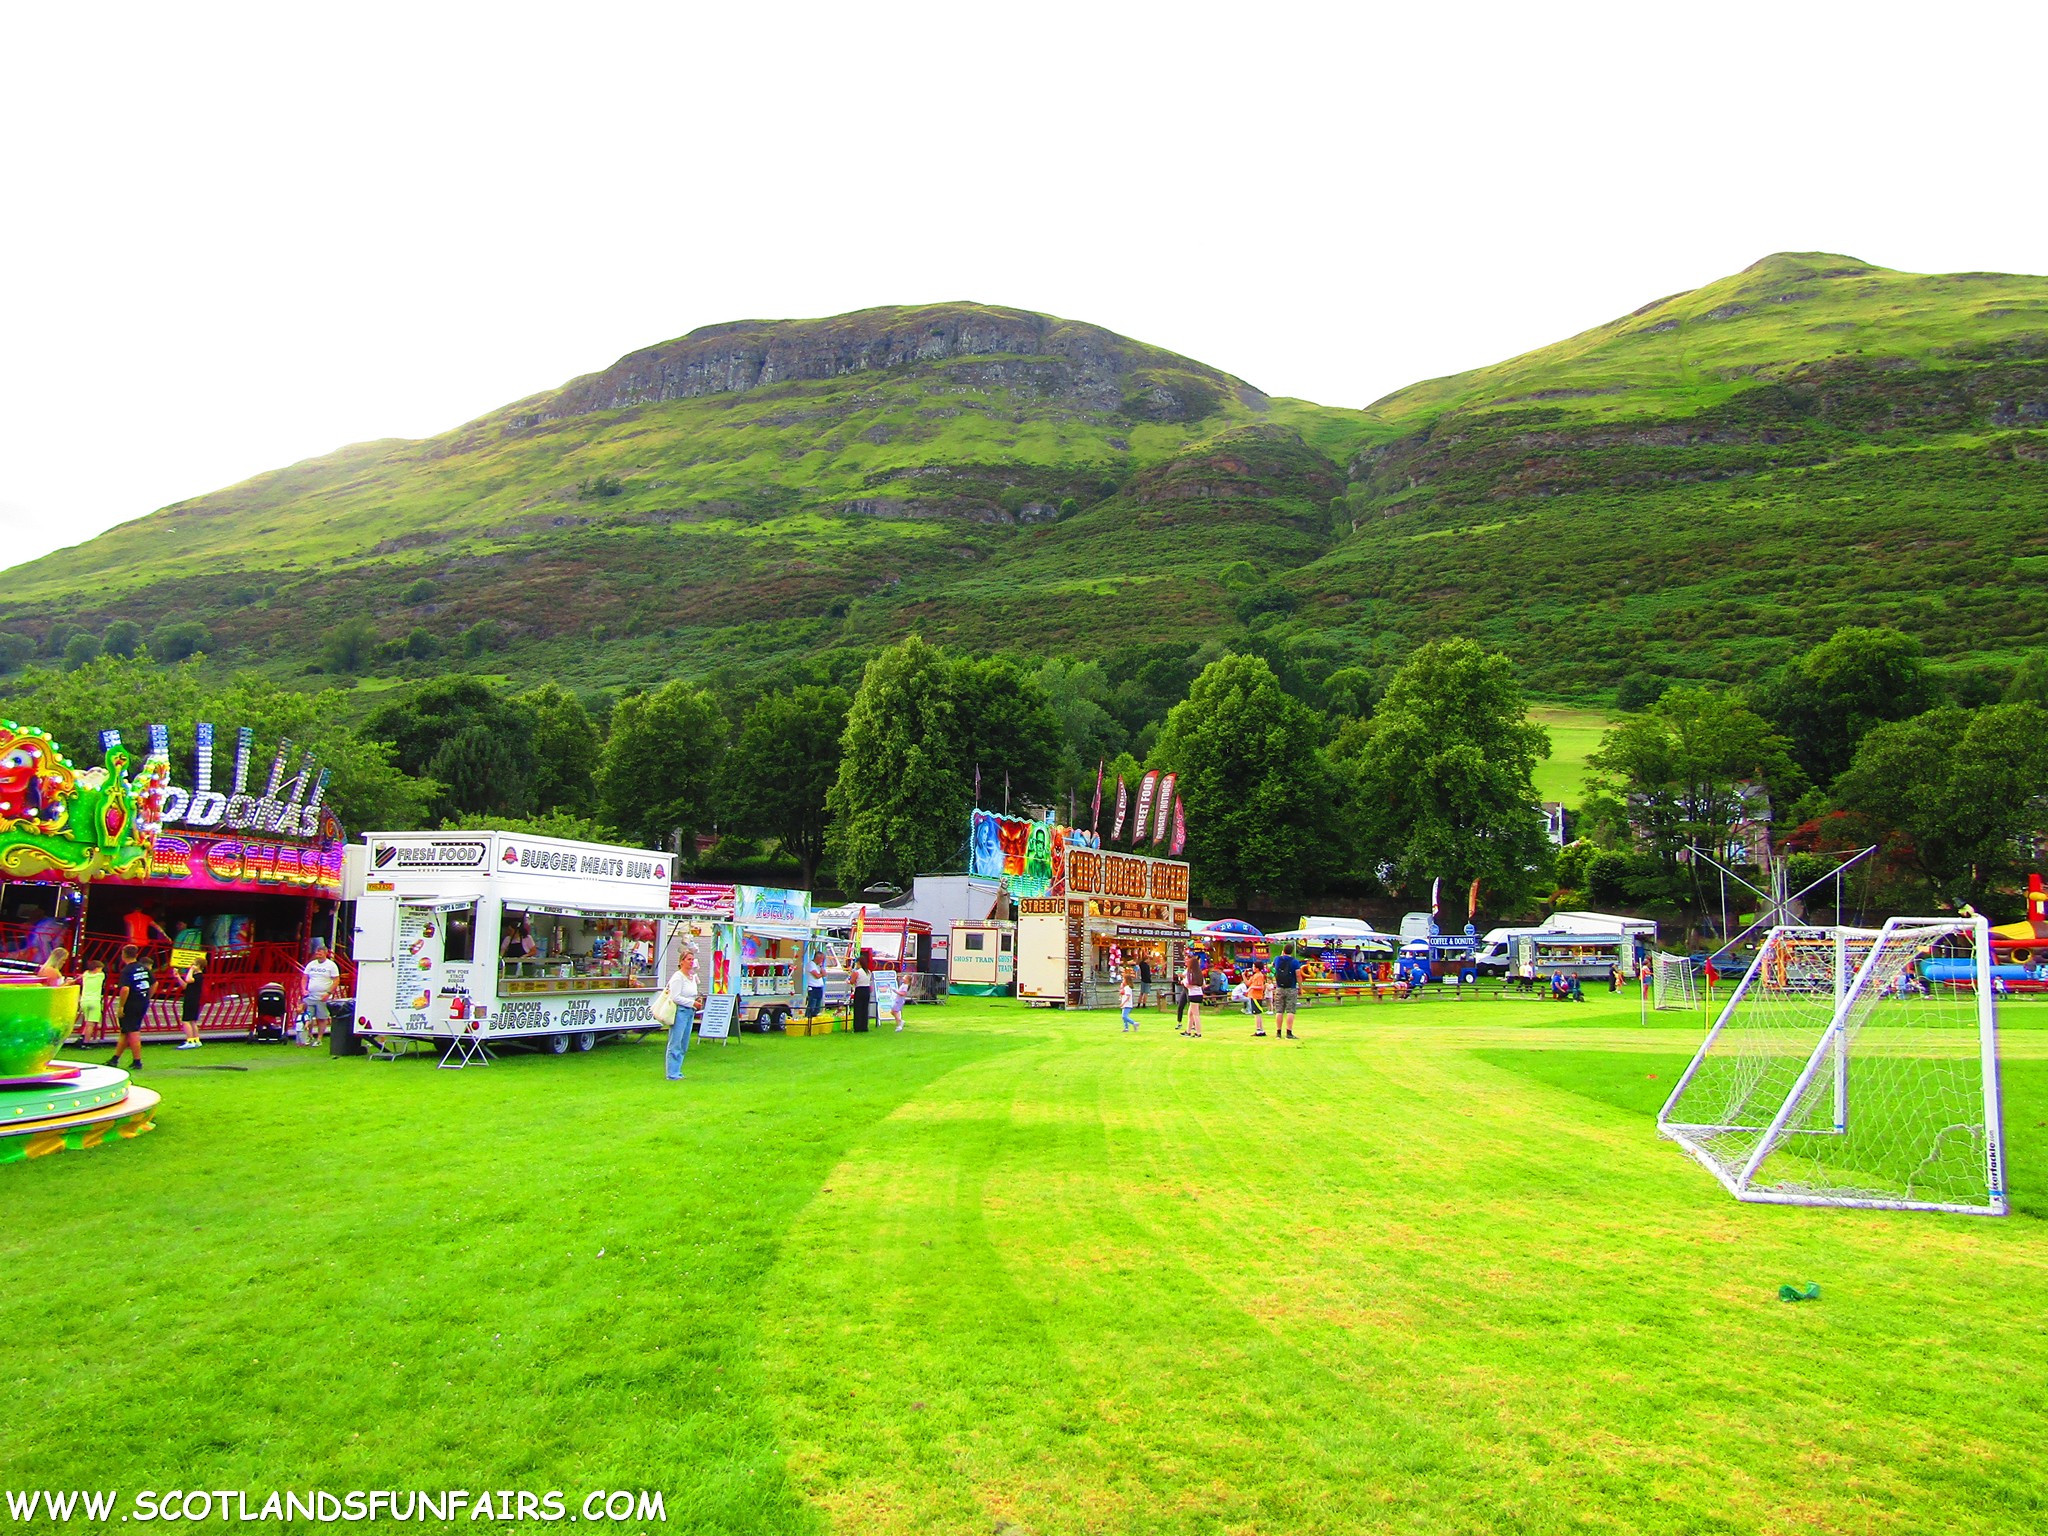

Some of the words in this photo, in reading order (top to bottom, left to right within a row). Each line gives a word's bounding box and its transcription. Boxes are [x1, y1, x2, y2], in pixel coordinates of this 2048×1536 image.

[1141, 777, 1155, 802] FOOD
[1136, 804, 1149, 837] STREET
[397, 848, 437, 861] FRESH
[439, 848, 477, 861] FOOD
[520, 849, 578, 872] BURGER
[580, 855, 623, 876] MEATS
[626, 861, 653, 879] BUN
[1068, 850, 1101, 894] CHIPS
[1105, 855, 1148, 899] BURGERS
[1150, 861, 1188, 901] CHICKEN
[1021, 898, 1055, 913] STREET
[1430, 937, 1448, 945] COFFEE
[1454, 937, 1474, 945] DONUTS
[998, 955, 1012, 963] GHOST
[998, 964, 1013, 972] TRAIN
[501, 1002, 541, 1012] DELICIOUS
[568, 1000, 591, 1010] TASTY
[618, 997, 650, 1007] AWESOME
[489, 1010, 550, 1030] BURGERS
[560, 1008, 596, 1026] CHIPS
[605, 1005, 657, 1024] HOTDOG
[405, 1021, 428, 1031] TASTY
